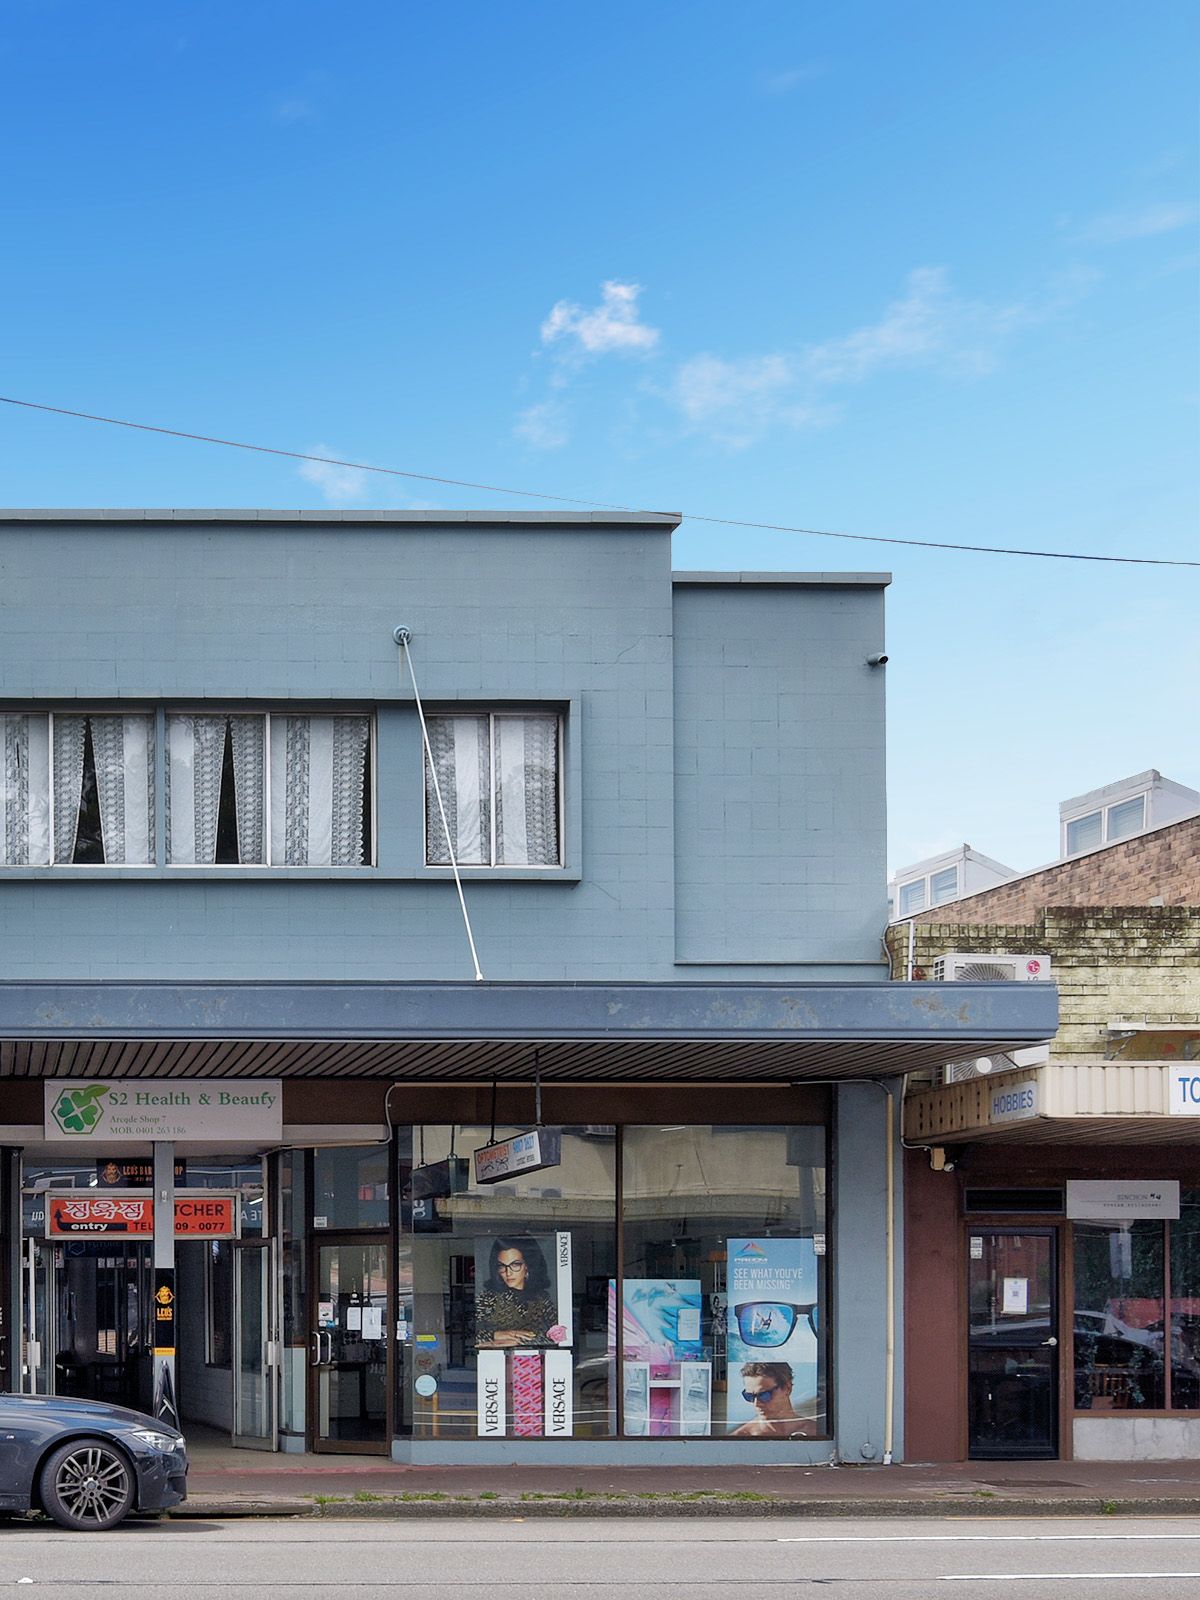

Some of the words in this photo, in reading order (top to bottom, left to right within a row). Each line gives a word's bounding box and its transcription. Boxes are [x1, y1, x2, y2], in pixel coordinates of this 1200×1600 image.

[109, 1092, 128, 1106] S2
[135, 1092, 191, 1106] Health
[198, 1093, 211, 1106] &
[218, 1091, 277, 1109] Beauty
[993, 1089, 1033, 1115] HOBBIES
[139, 1115, 160, 1125] Shop
[135, 1126, 154, 1134] 0401
[63, 1200, 145, 1220] 정육점
[152, 1204, 225, 1216] TCHER
[71, 1223, 108, 1231] entry
[133, 1222, 153, 1230] TEL
[198, 1222, 225, 1230] 0077
[560, 1234, 568, 1267] VERSACE
[733, 1268, 748, 1279] SEE
[750, 1268, 773, 1279] WHAT
[774, 1268, 803, 1279] YOU'VE
[733, 1280, 754, 1290] BEEN
[485, 1378, 499, 1433] VERSACE
[553, 1378, 566, 1432] VERSACE
